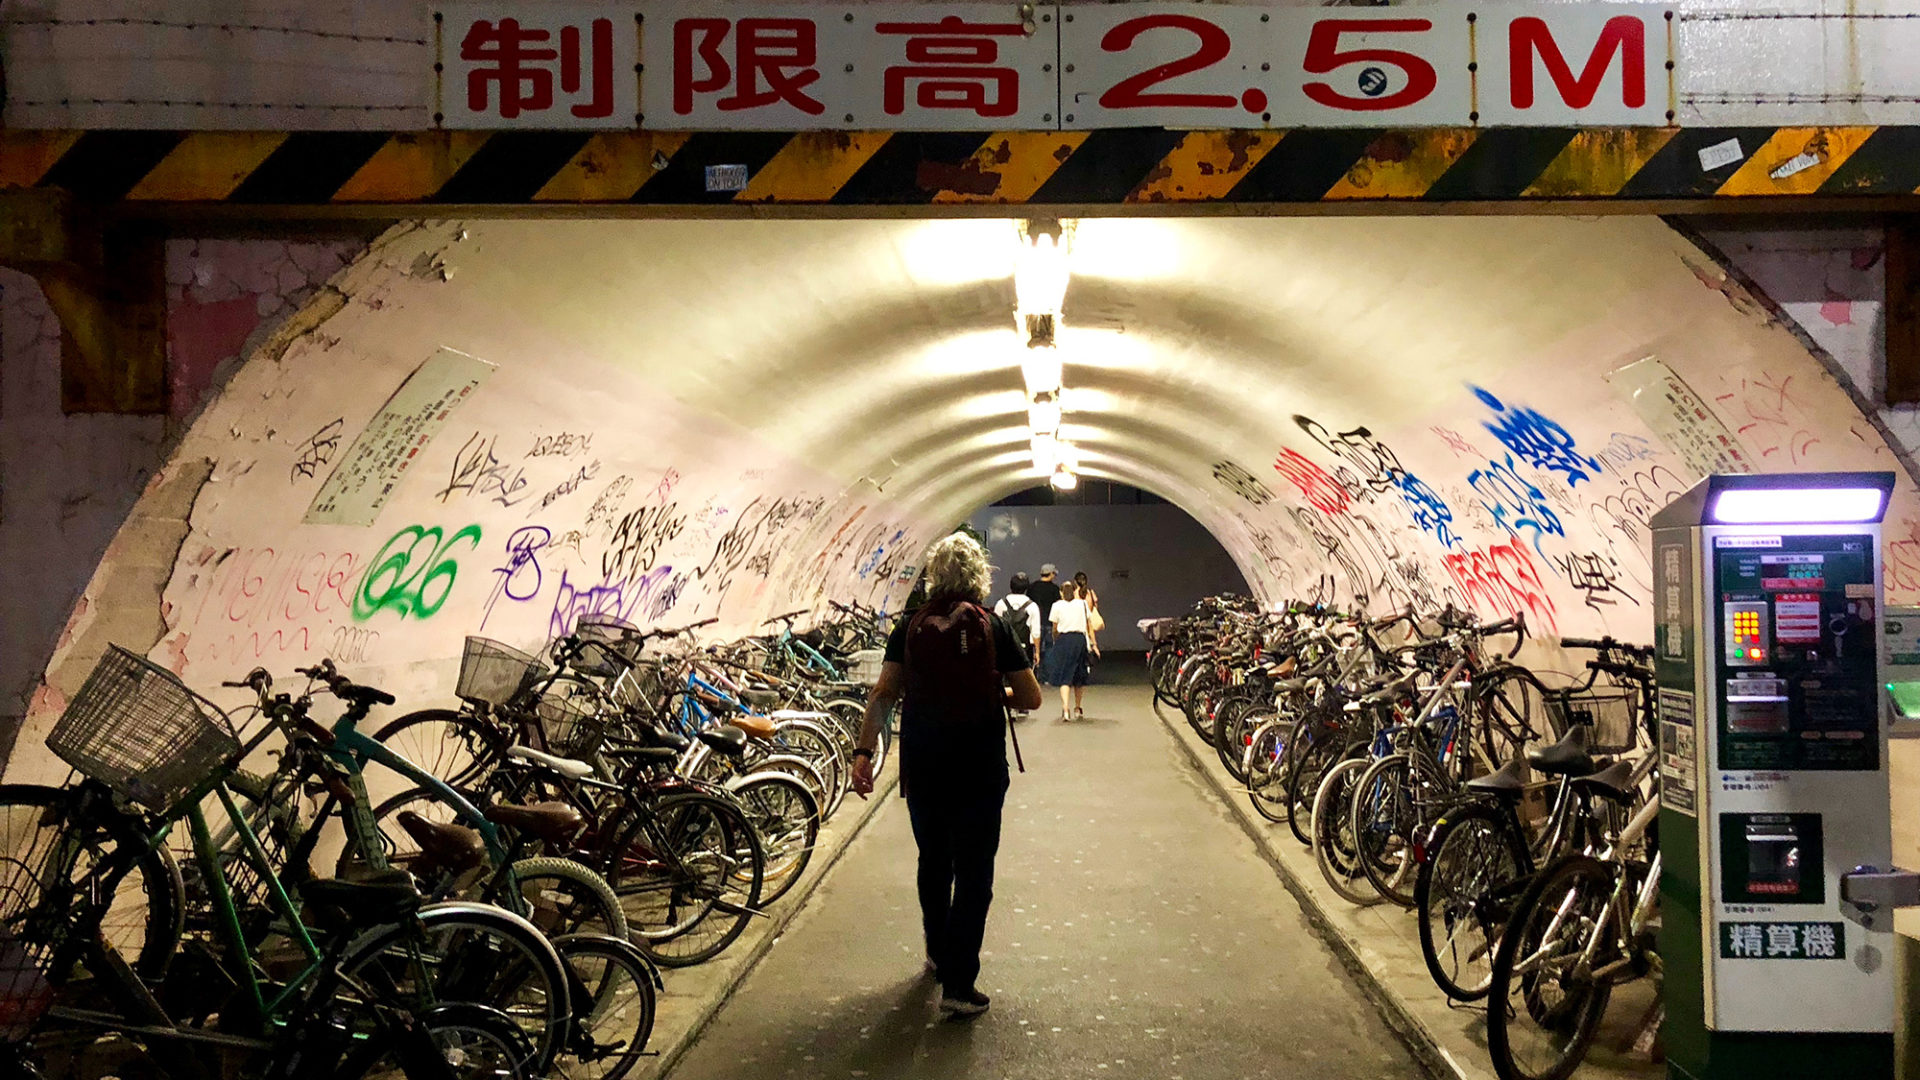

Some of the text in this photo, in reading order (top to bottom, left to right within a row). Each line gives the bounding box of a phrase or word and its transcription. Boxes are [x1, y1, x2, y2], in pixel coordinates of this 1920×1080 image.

[460, 17, 1025, 119] 制限高
[353, 523, 482, 622] 626
[1730, 924, 1835, 956] 精算機
